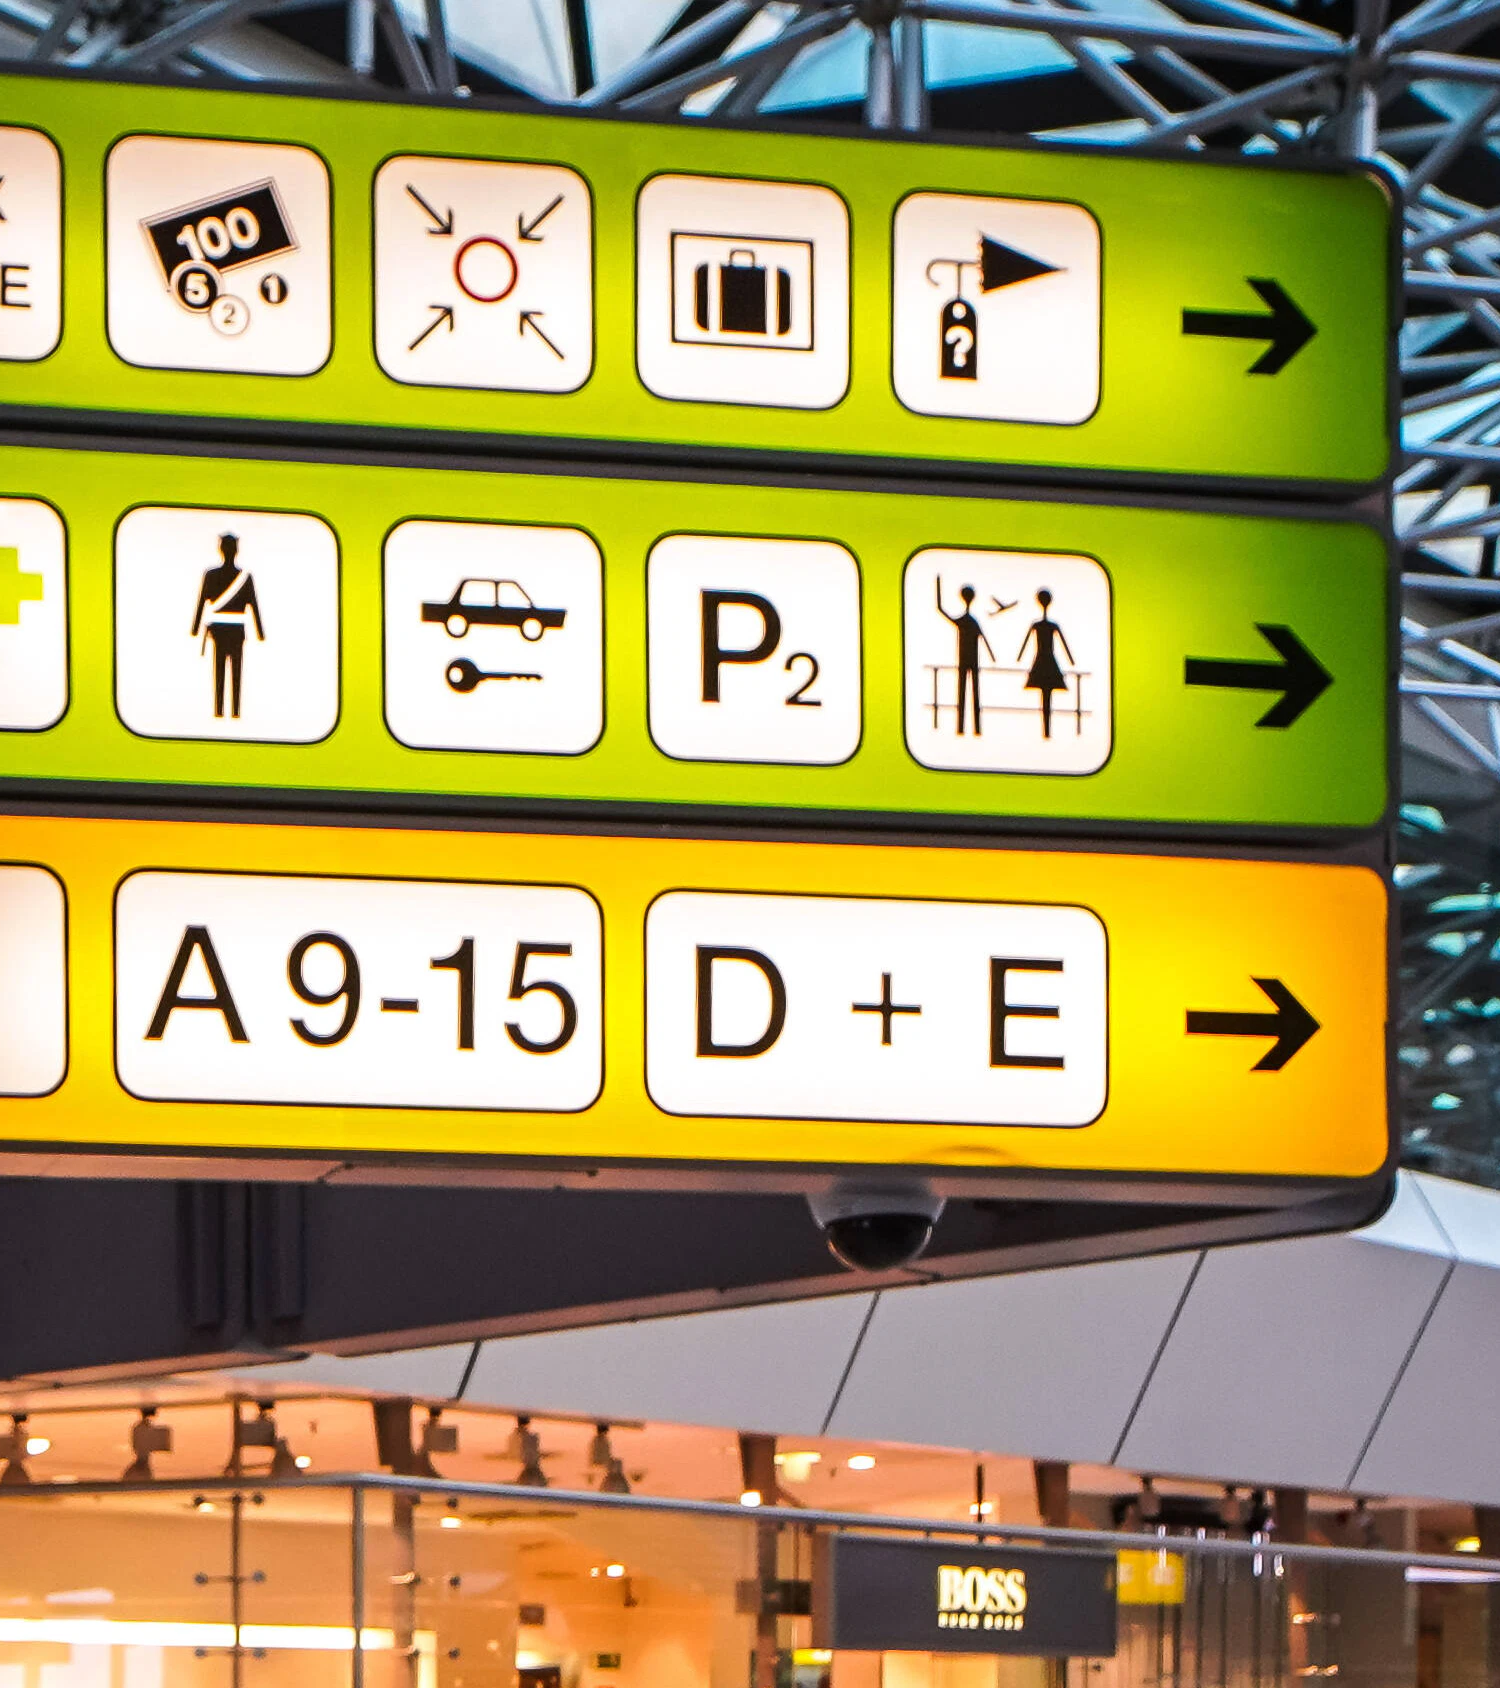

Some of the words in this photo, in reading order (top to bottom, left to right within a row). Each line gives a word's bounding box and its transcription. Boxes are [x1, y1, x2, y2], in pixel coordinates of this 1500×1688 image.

[701, 588, 823, 707] P2
[143, 924, 251, 1044] A
[285, 929, 579, 1056] 9-15
[695, 944, 788, 1059] D
[851, 971, 922, 1046] +
[989, 956, 1066, 1070] E
[938, 1565, 1027, 1614] BOSS
